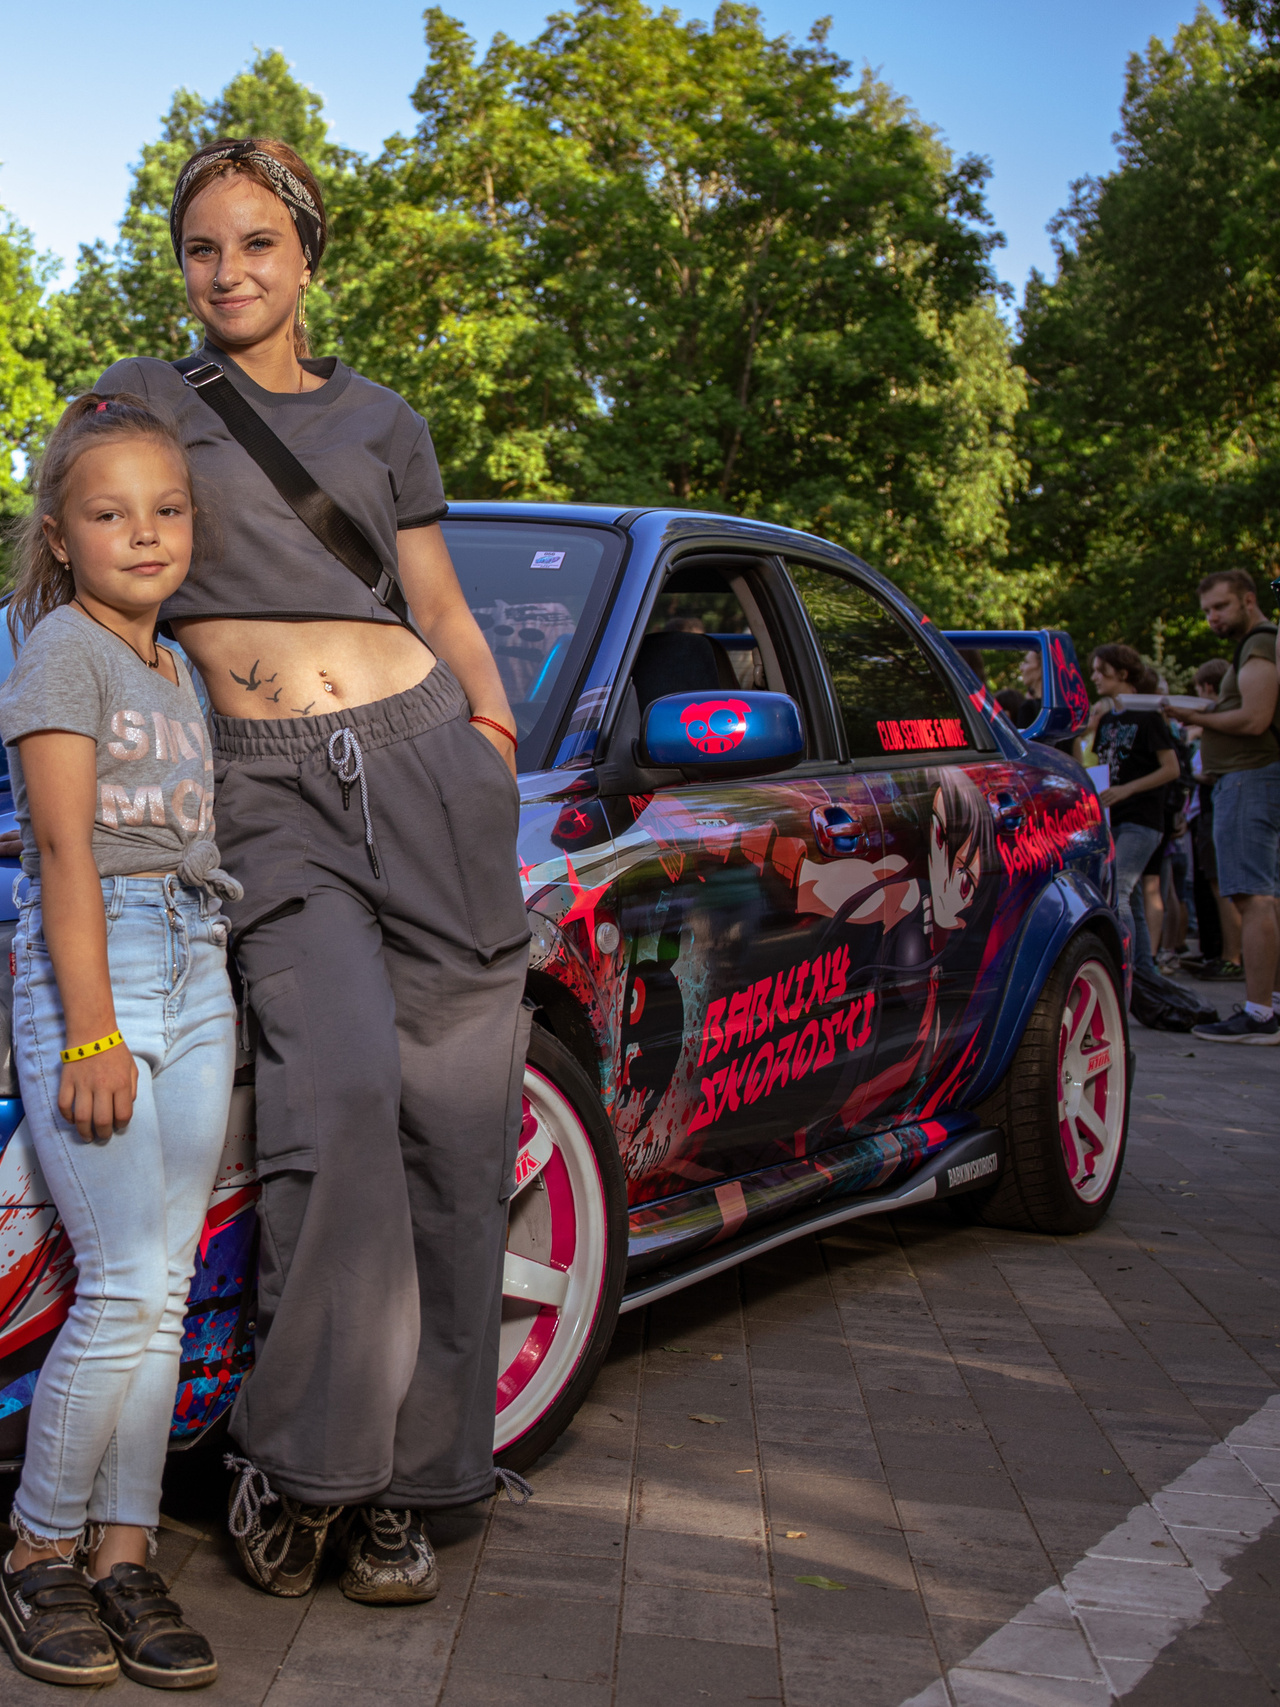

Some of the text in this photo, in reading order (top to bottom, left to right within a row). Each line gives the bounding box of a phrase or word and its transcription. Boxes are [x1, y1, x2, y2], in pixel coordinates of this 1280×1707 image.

[877, 720, 904, 751] CLUB
[900, 718, 939, 750] SERVICE
[947, 1152, 998, 1189] BABKINYSKOROSTI
